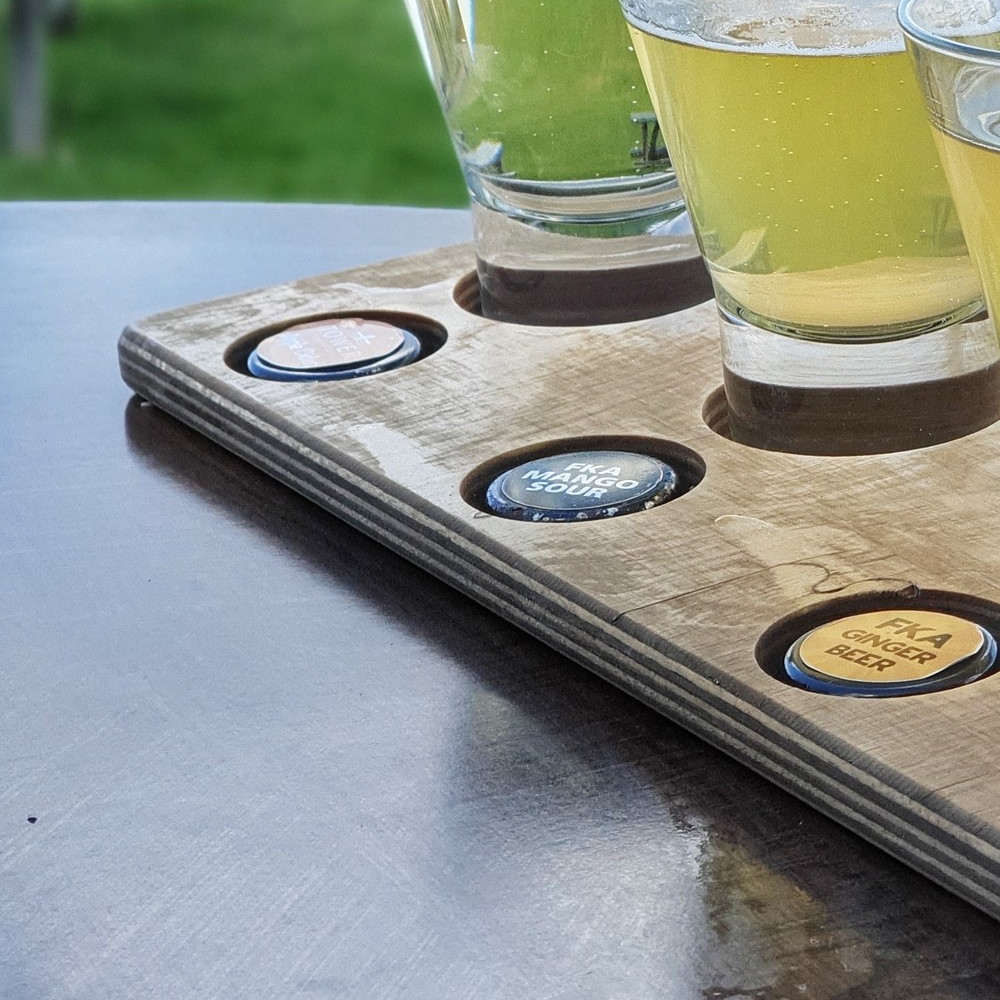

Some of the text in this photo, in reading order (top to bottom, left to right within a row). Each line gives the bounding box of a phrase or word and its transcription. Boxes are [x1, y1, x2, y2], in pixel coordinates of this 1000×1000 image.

[522, 470, 639, 489] MANGO
[564, 463, 621, 476] FKA
[526, 482, 608, 498] SOUR
[875, 617, 952, 649] FKA
[824, 644, 896, 672] BEER
[842, 629, 937, 665] GINGER
